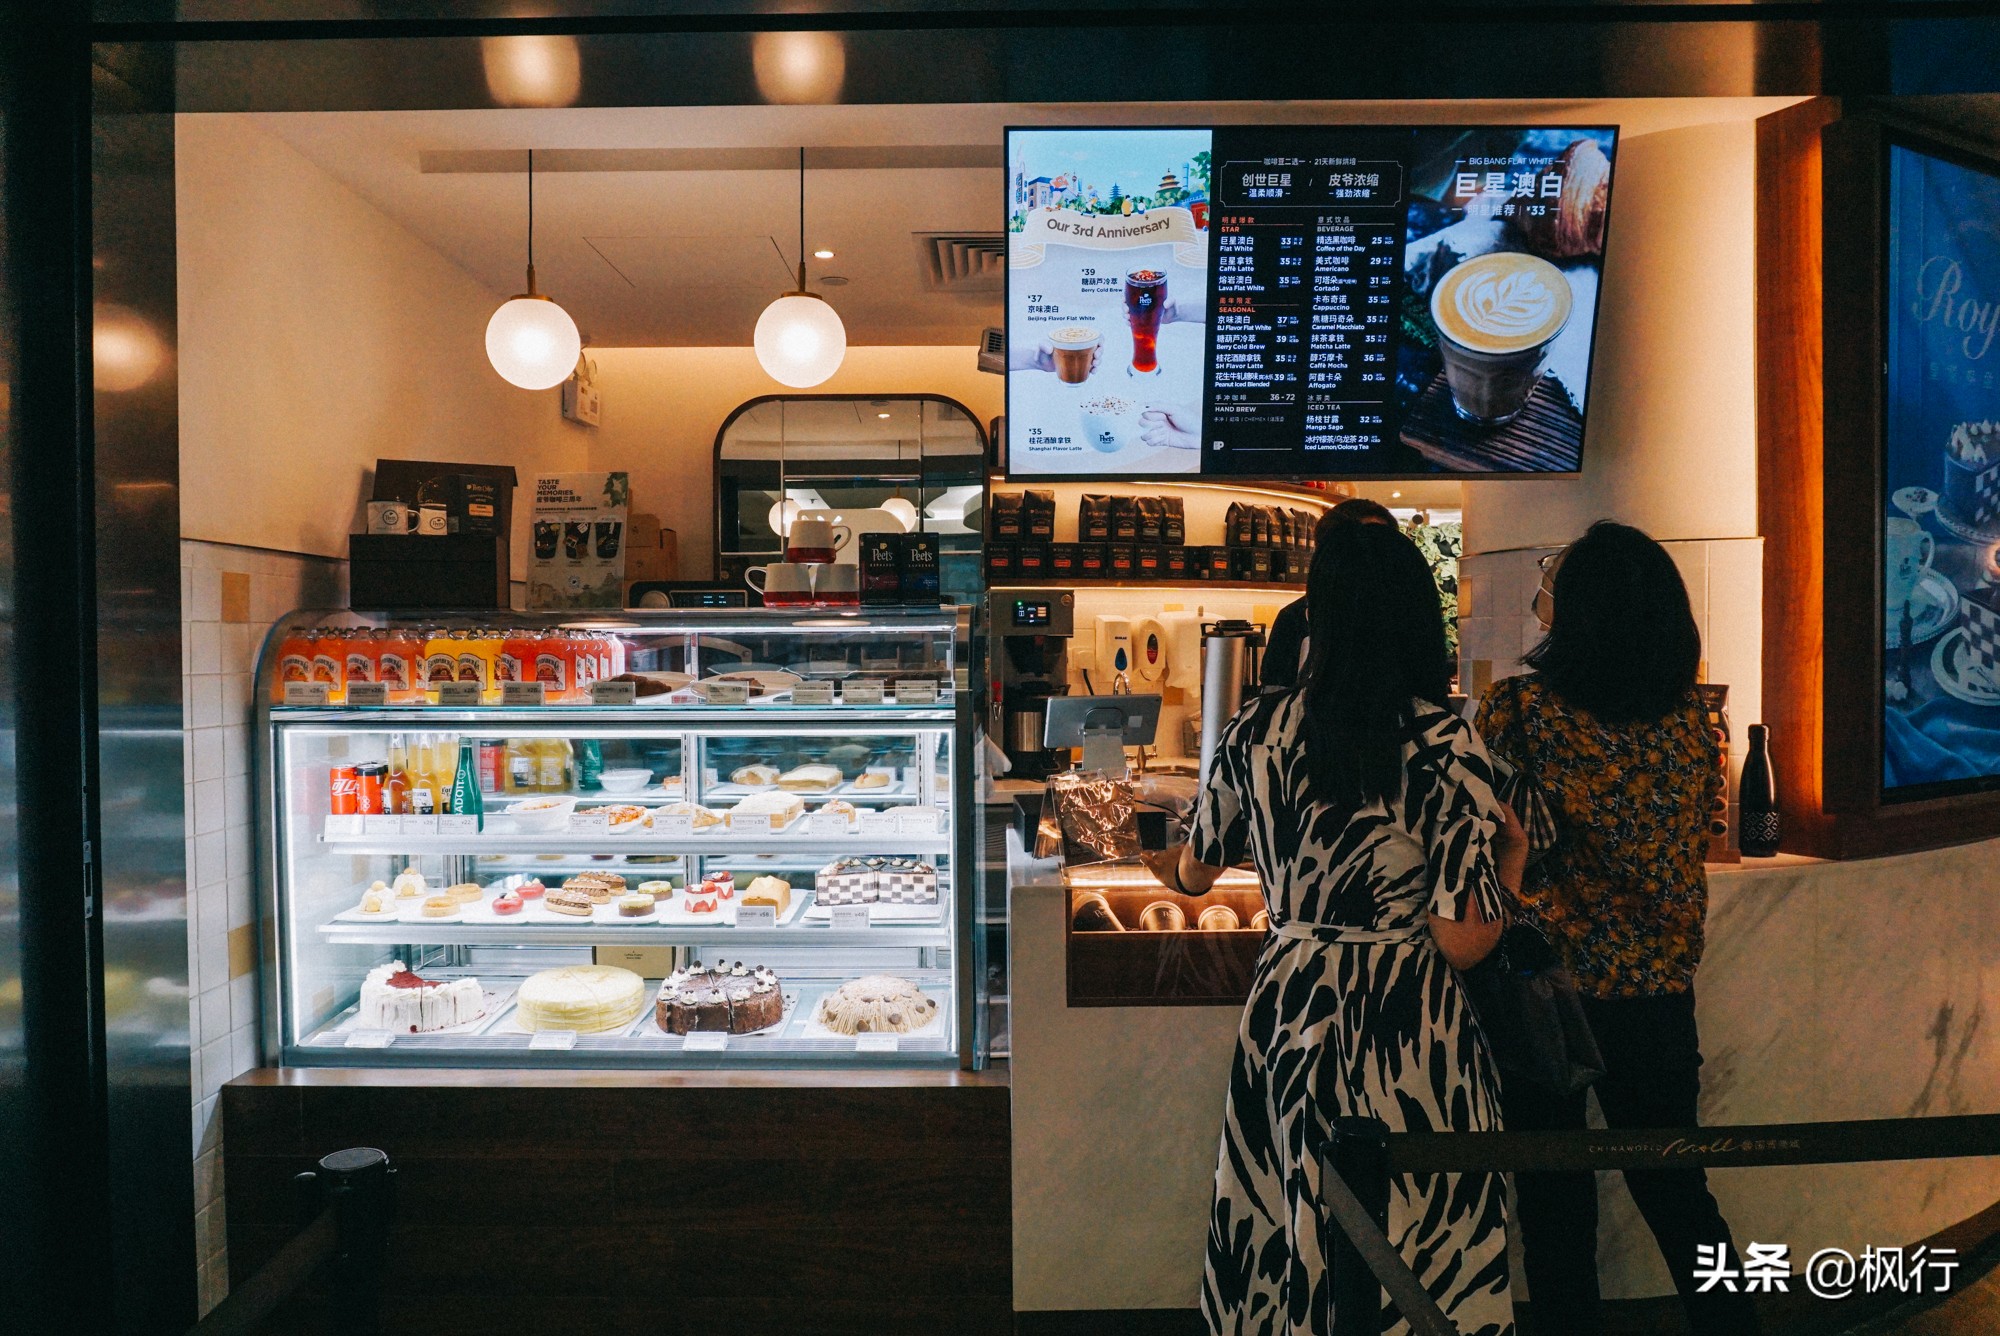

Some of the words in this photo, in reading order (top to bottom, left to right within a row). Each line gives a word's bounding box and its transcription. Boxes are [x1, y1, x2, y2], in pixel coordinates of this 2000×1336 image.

[1242, 174, 1292, 186] 创世巨星
[1328, 174, 1380, 186] 皮爷浓缩
[1455, 172, 1562, 198] 巨星澳白
[1249, 188, 1284, 198] 温柔顺滑
[1336, 188, 1370, 198] 强劲浓缩
[1468, 204, 1516, 216] 明星推荐
[1526, 205, 1546, 216] ¥33
[1047, 218, 1070, 232] Our
[1072, 224, 1094, 238] 3rd
[1096, 217, 1170, 238] Anniversary
[1220, 236, 1254, 245] 巨星澳白
[1316, 236, 1356, 244] 精选黑咖啡
[1220, 256, 1254, 265] 巨星拿铁
[1316, 256, 1349, 265] 美式咖啡
[1081, 278, 1118, 286] 糖葫芦冷萃
[1219, 276, 1252, 284] 熔岩澳白
[1314, 295, 1347, 303] 卡布奇诺
[1028, 305, 1059, 313] 京味澳白
[1218, 316, 1250, 324] 京味澳白
[1313, 315, 1354, 323] 焦糖玛奇朵
[1312, 334, 1344, 342] 抹茶拿铁
[1216, 354, 1261, 362] 桂花酒酿拿铁
[1306, 415, 1339, 423] 杨枝甘露
[910, 548, 933, 562] Peet's
[454, 780, 465, 815] ADOIT
